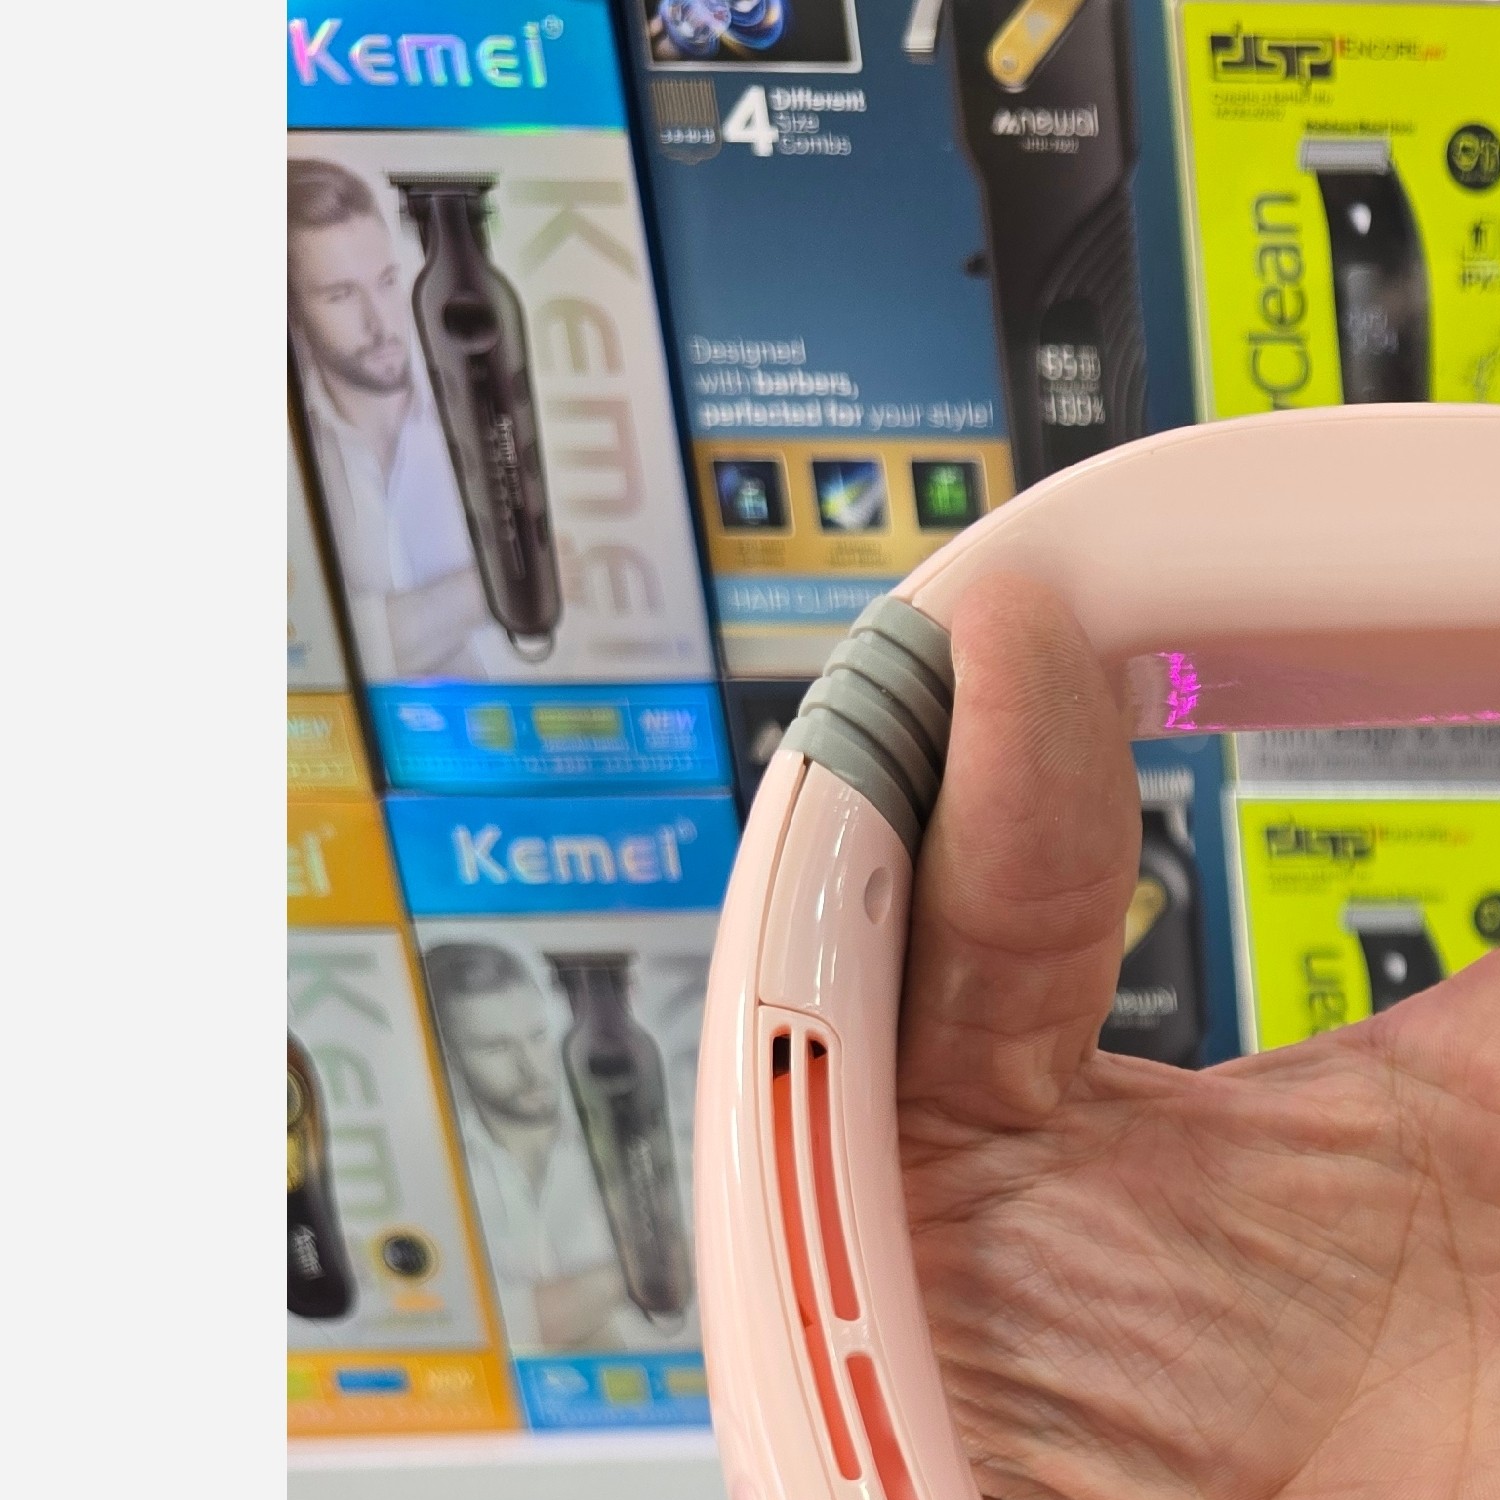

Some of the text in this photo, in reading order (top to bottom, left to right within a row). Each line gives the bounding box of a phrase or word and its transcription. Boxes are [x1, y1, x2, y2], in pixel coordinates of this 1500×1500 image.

[288, 17, 548, 88] Kemei
[722, 84, 780, 157] 4
[1250, 192, 1310, 411] Clean
[690, 336, 806, 367] Designed
[452, 820, 684, 885] Kemei
